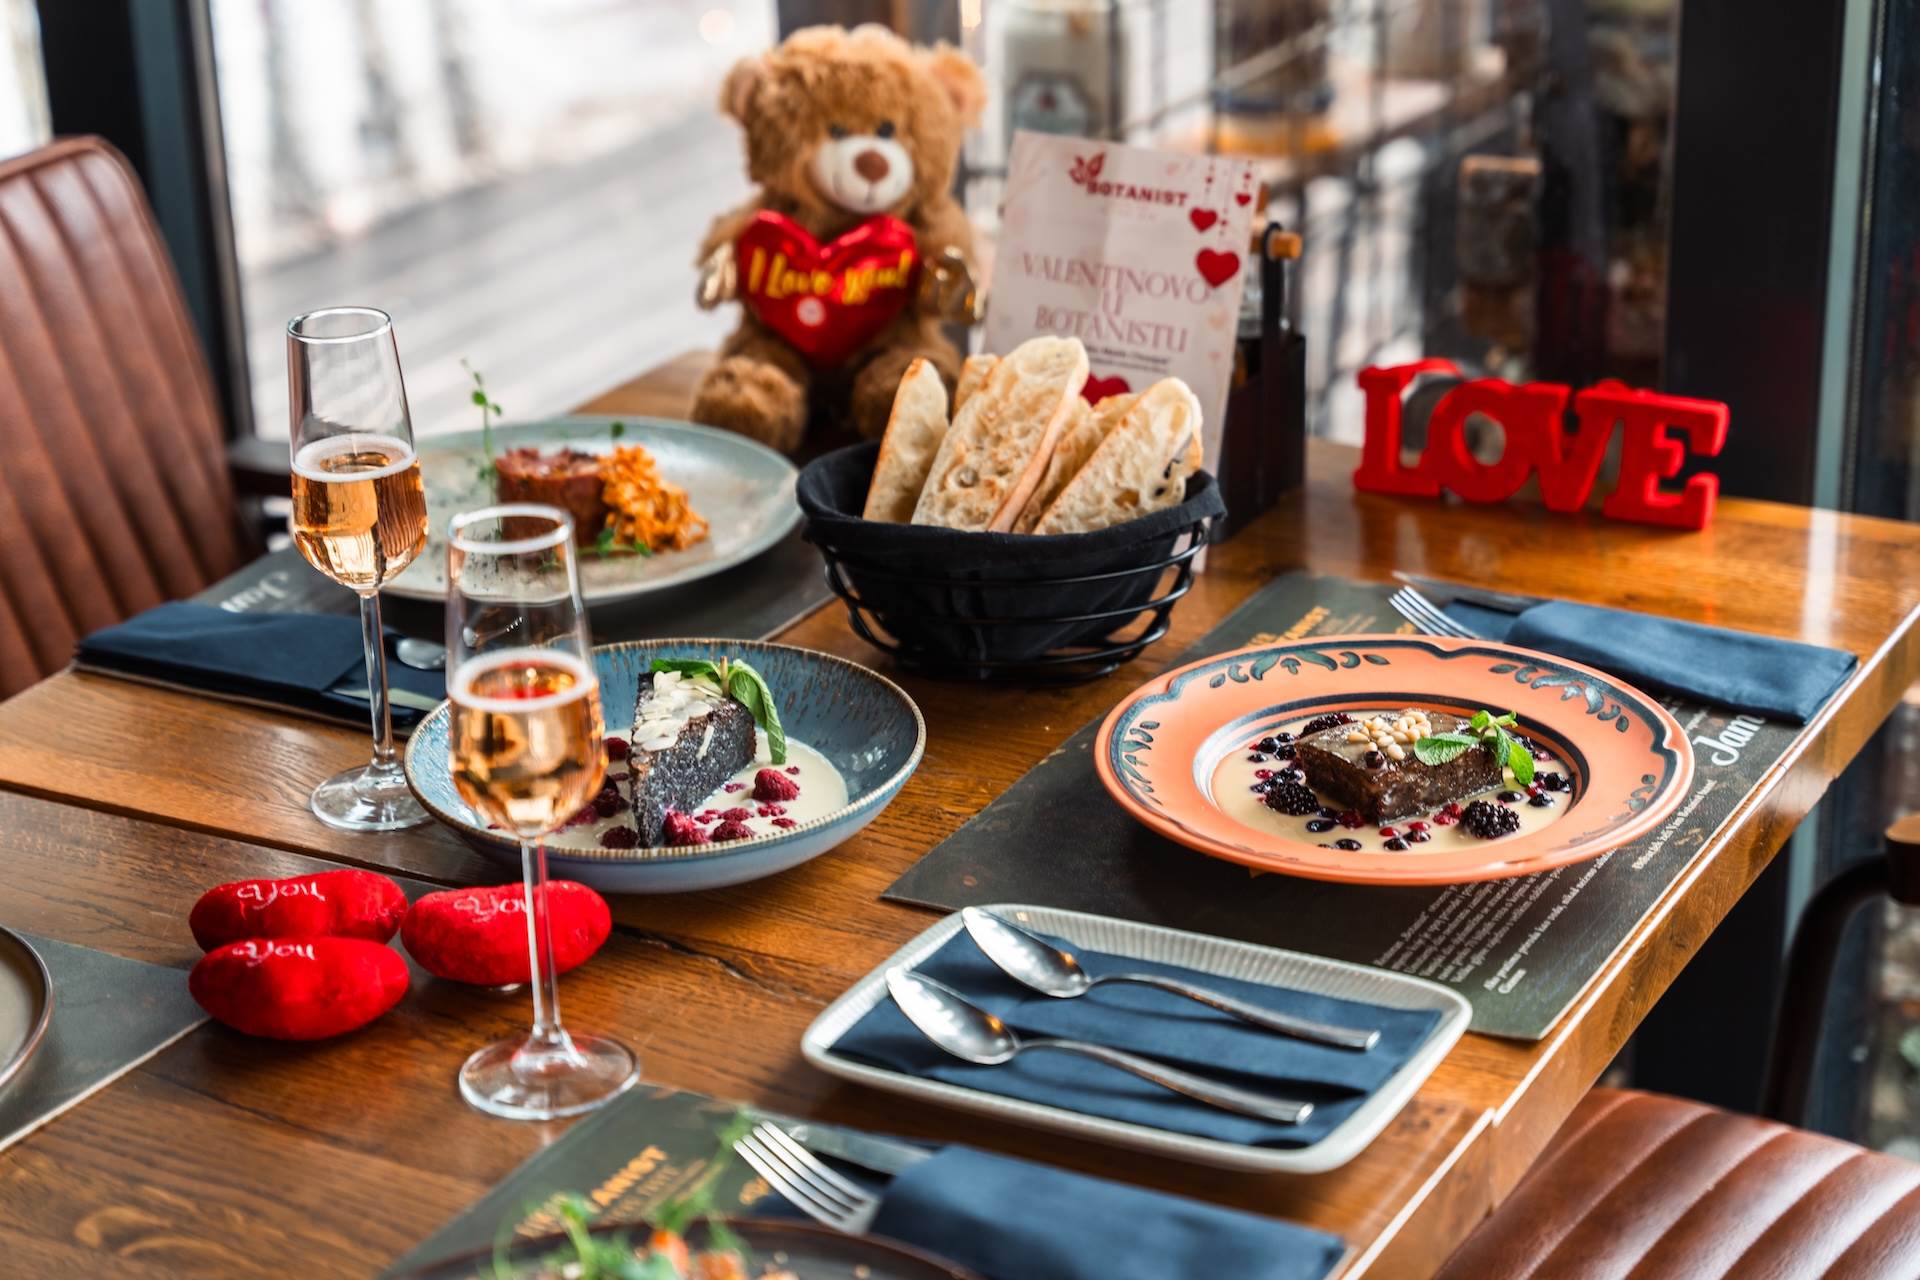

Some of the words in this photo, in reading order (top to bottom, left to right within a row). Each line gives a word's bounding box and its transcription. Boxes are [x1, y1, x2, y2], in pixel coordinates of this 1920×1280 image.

[1086, 182, 1188, 207] BOTANIST
[1023, 252, 1213, 304] VALENTINOVO
[1034, 304, 1188, 353] BOTANISTU
[1353, 357, 1729, 530] LOVE
